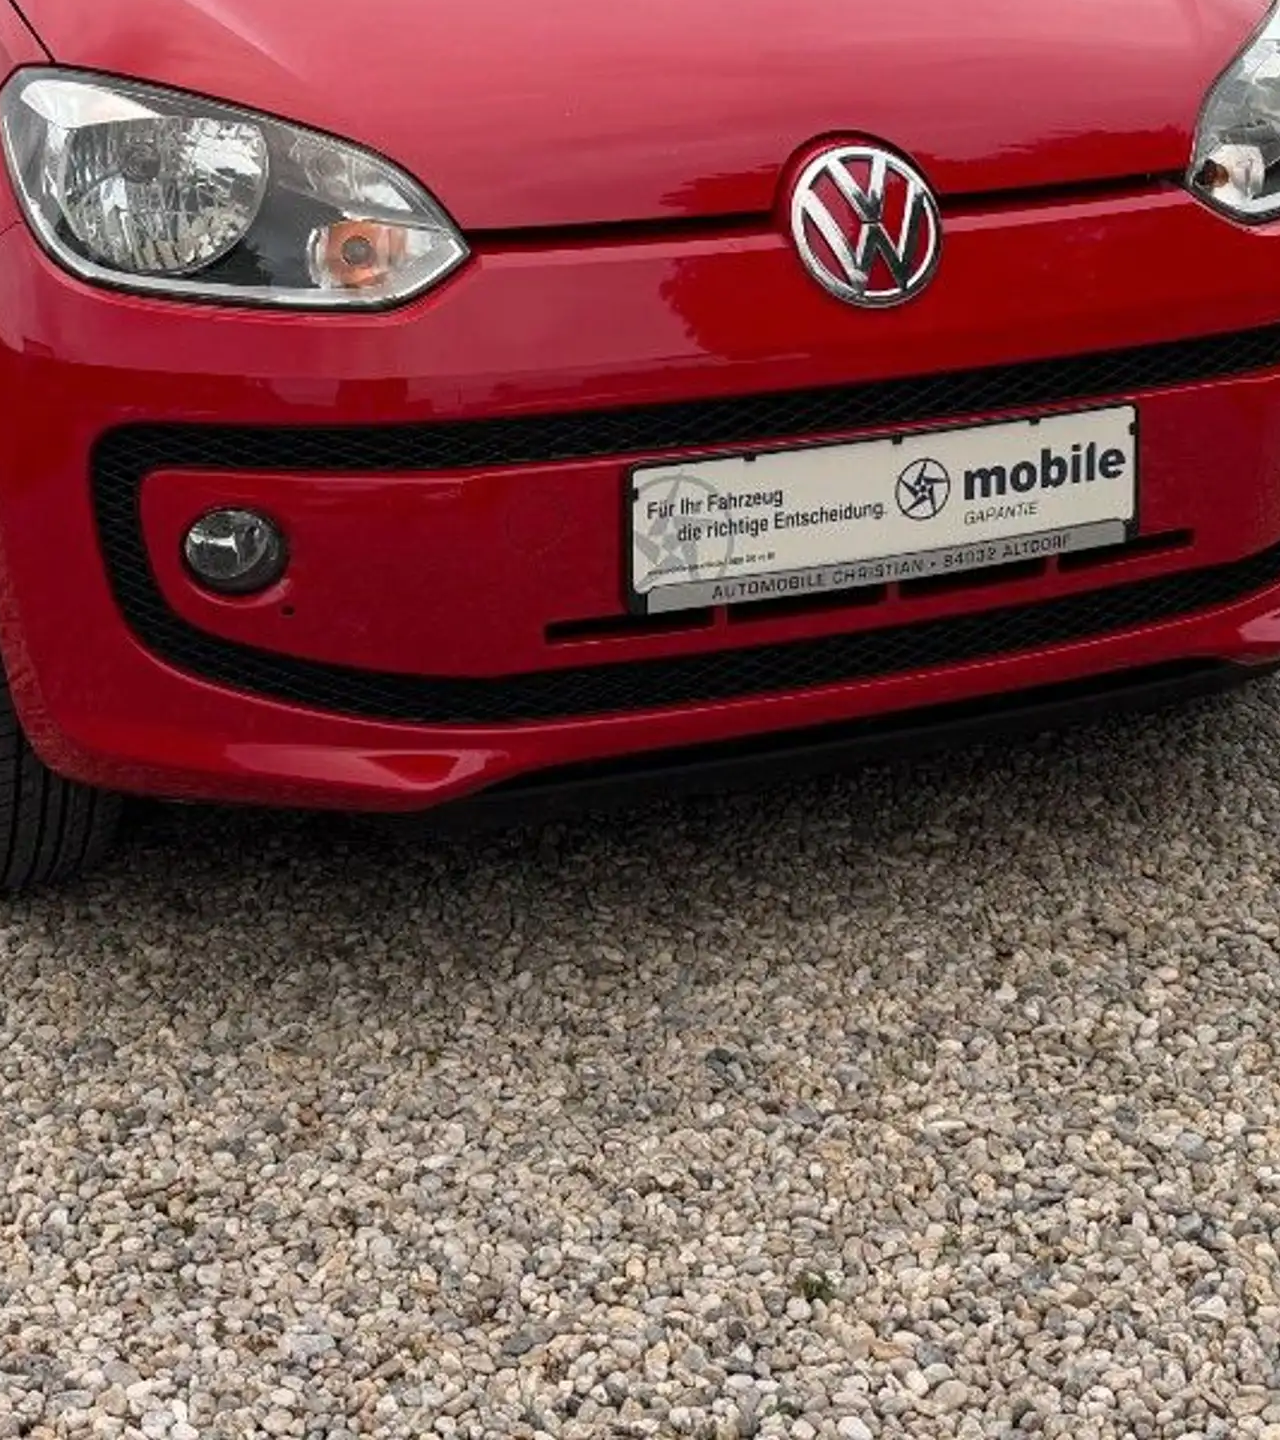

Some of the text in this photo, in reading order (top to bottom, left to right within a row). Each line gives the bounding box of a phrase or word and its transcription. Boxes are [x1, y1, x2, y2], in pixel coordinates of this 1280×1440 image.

[964, 441, 1126, 500] mobile
[647, 489, 783, 520] Für Ihr Fahrzeug
[677, 502, 887, 543] die richtige Entscheidung.
[964, 502, 1038, 526] GARANTIE
[711, 534, 1070, 601] AUTOMOBILE CHRISTIAN 84032 ALTDORF
